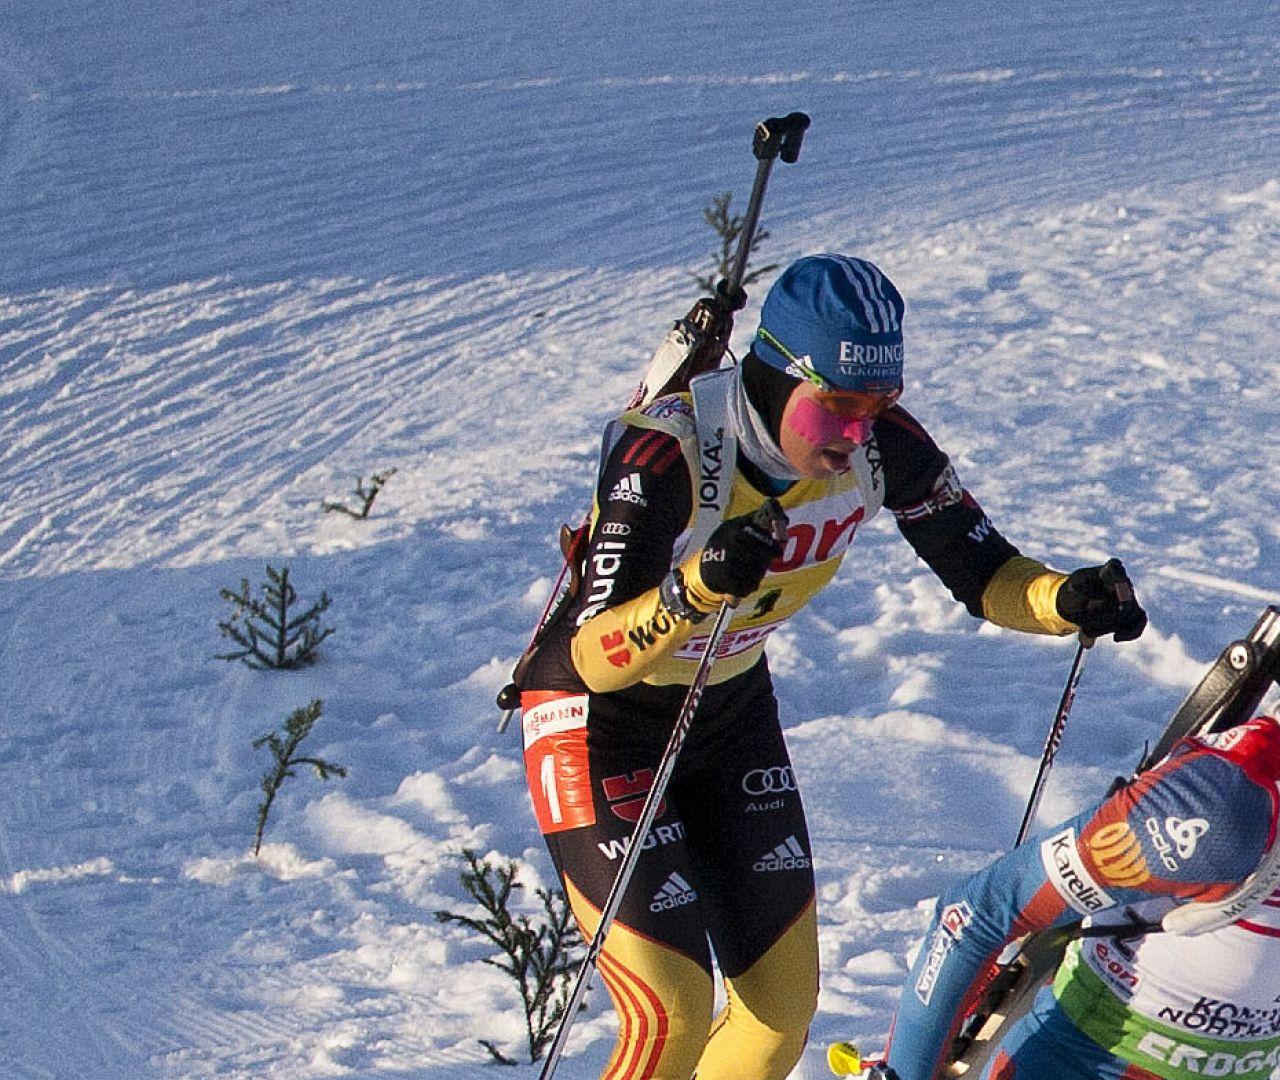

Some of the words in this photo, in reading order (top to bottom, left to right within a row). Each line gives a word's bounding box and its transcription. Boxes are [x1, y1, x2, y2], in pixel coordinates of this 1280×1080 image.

[744, 800, 784, 812] Audi
[752, 856, 812, 872] adidas
[1052, 835, 1103, 910] Karelia
